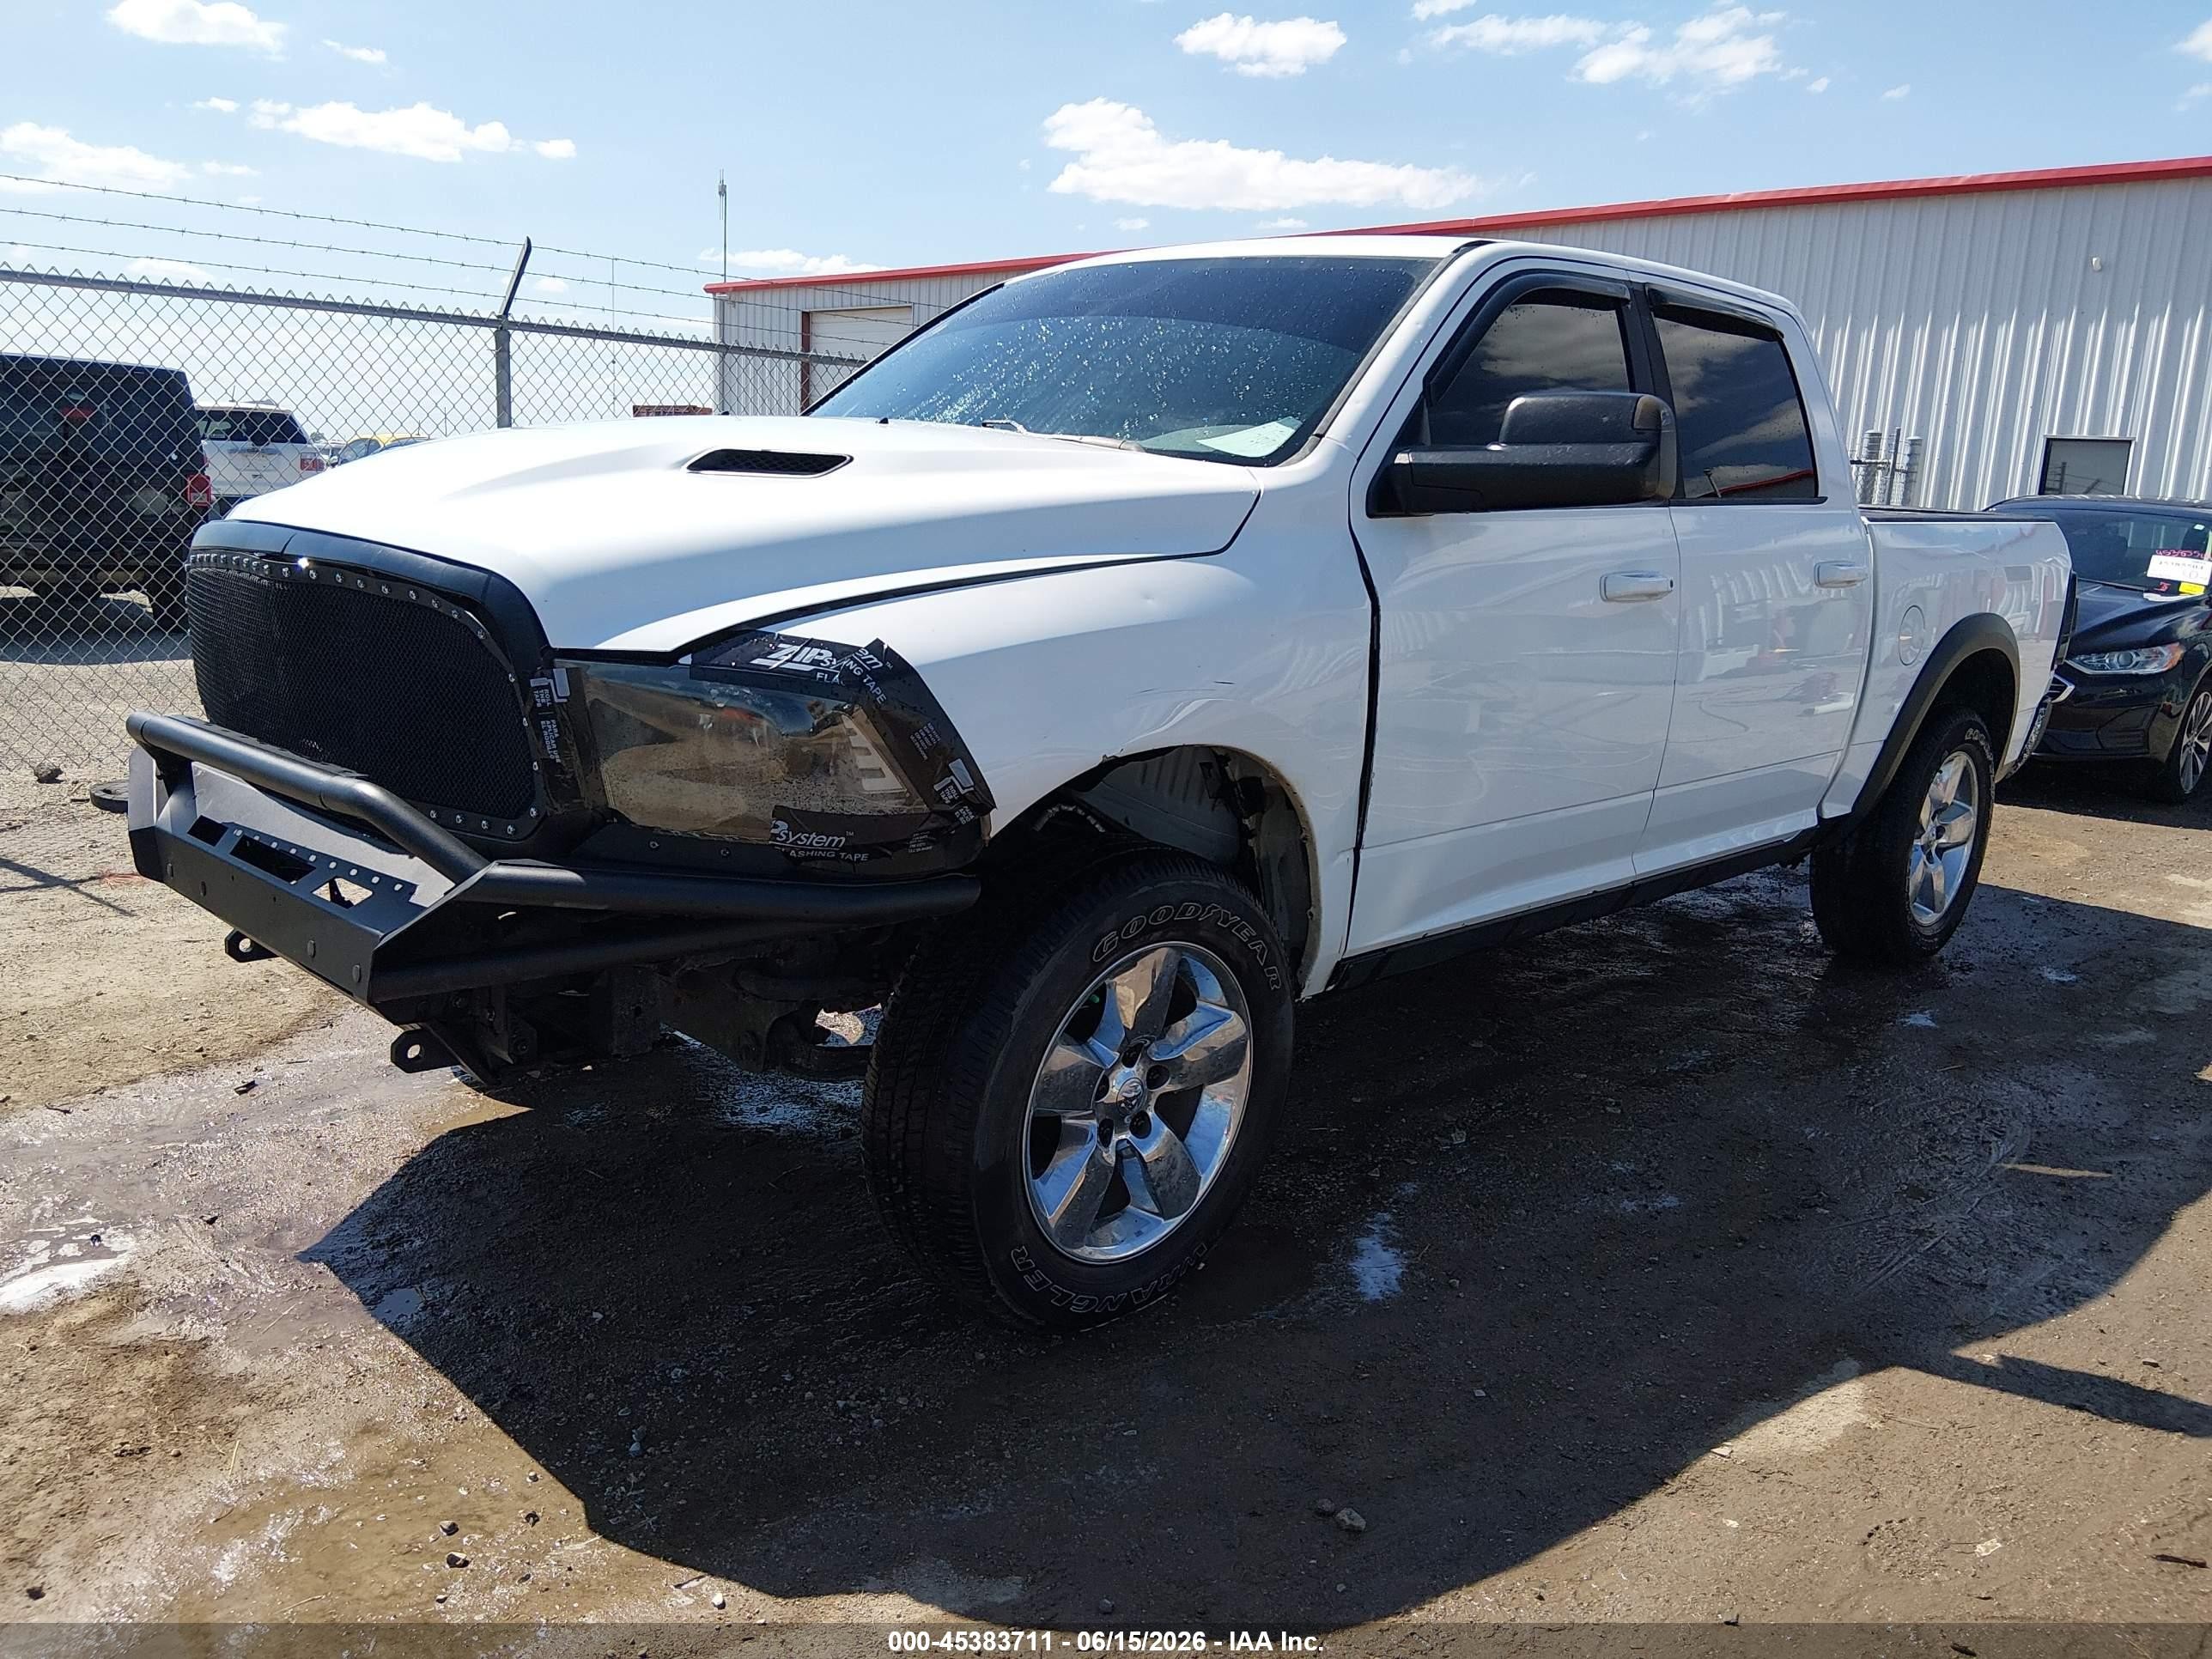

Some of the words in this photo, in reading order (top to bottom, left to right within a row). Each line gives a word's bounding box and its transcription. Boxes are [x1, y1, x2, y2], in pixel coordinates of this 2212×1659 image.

[863, 674, 887, 704] TAPE
[838, 852, 869, 861] TAPE
[1092, 902, 1282, 991] GOODYEAR
[1011, 1243, 1208, 1314] WRANGLER
